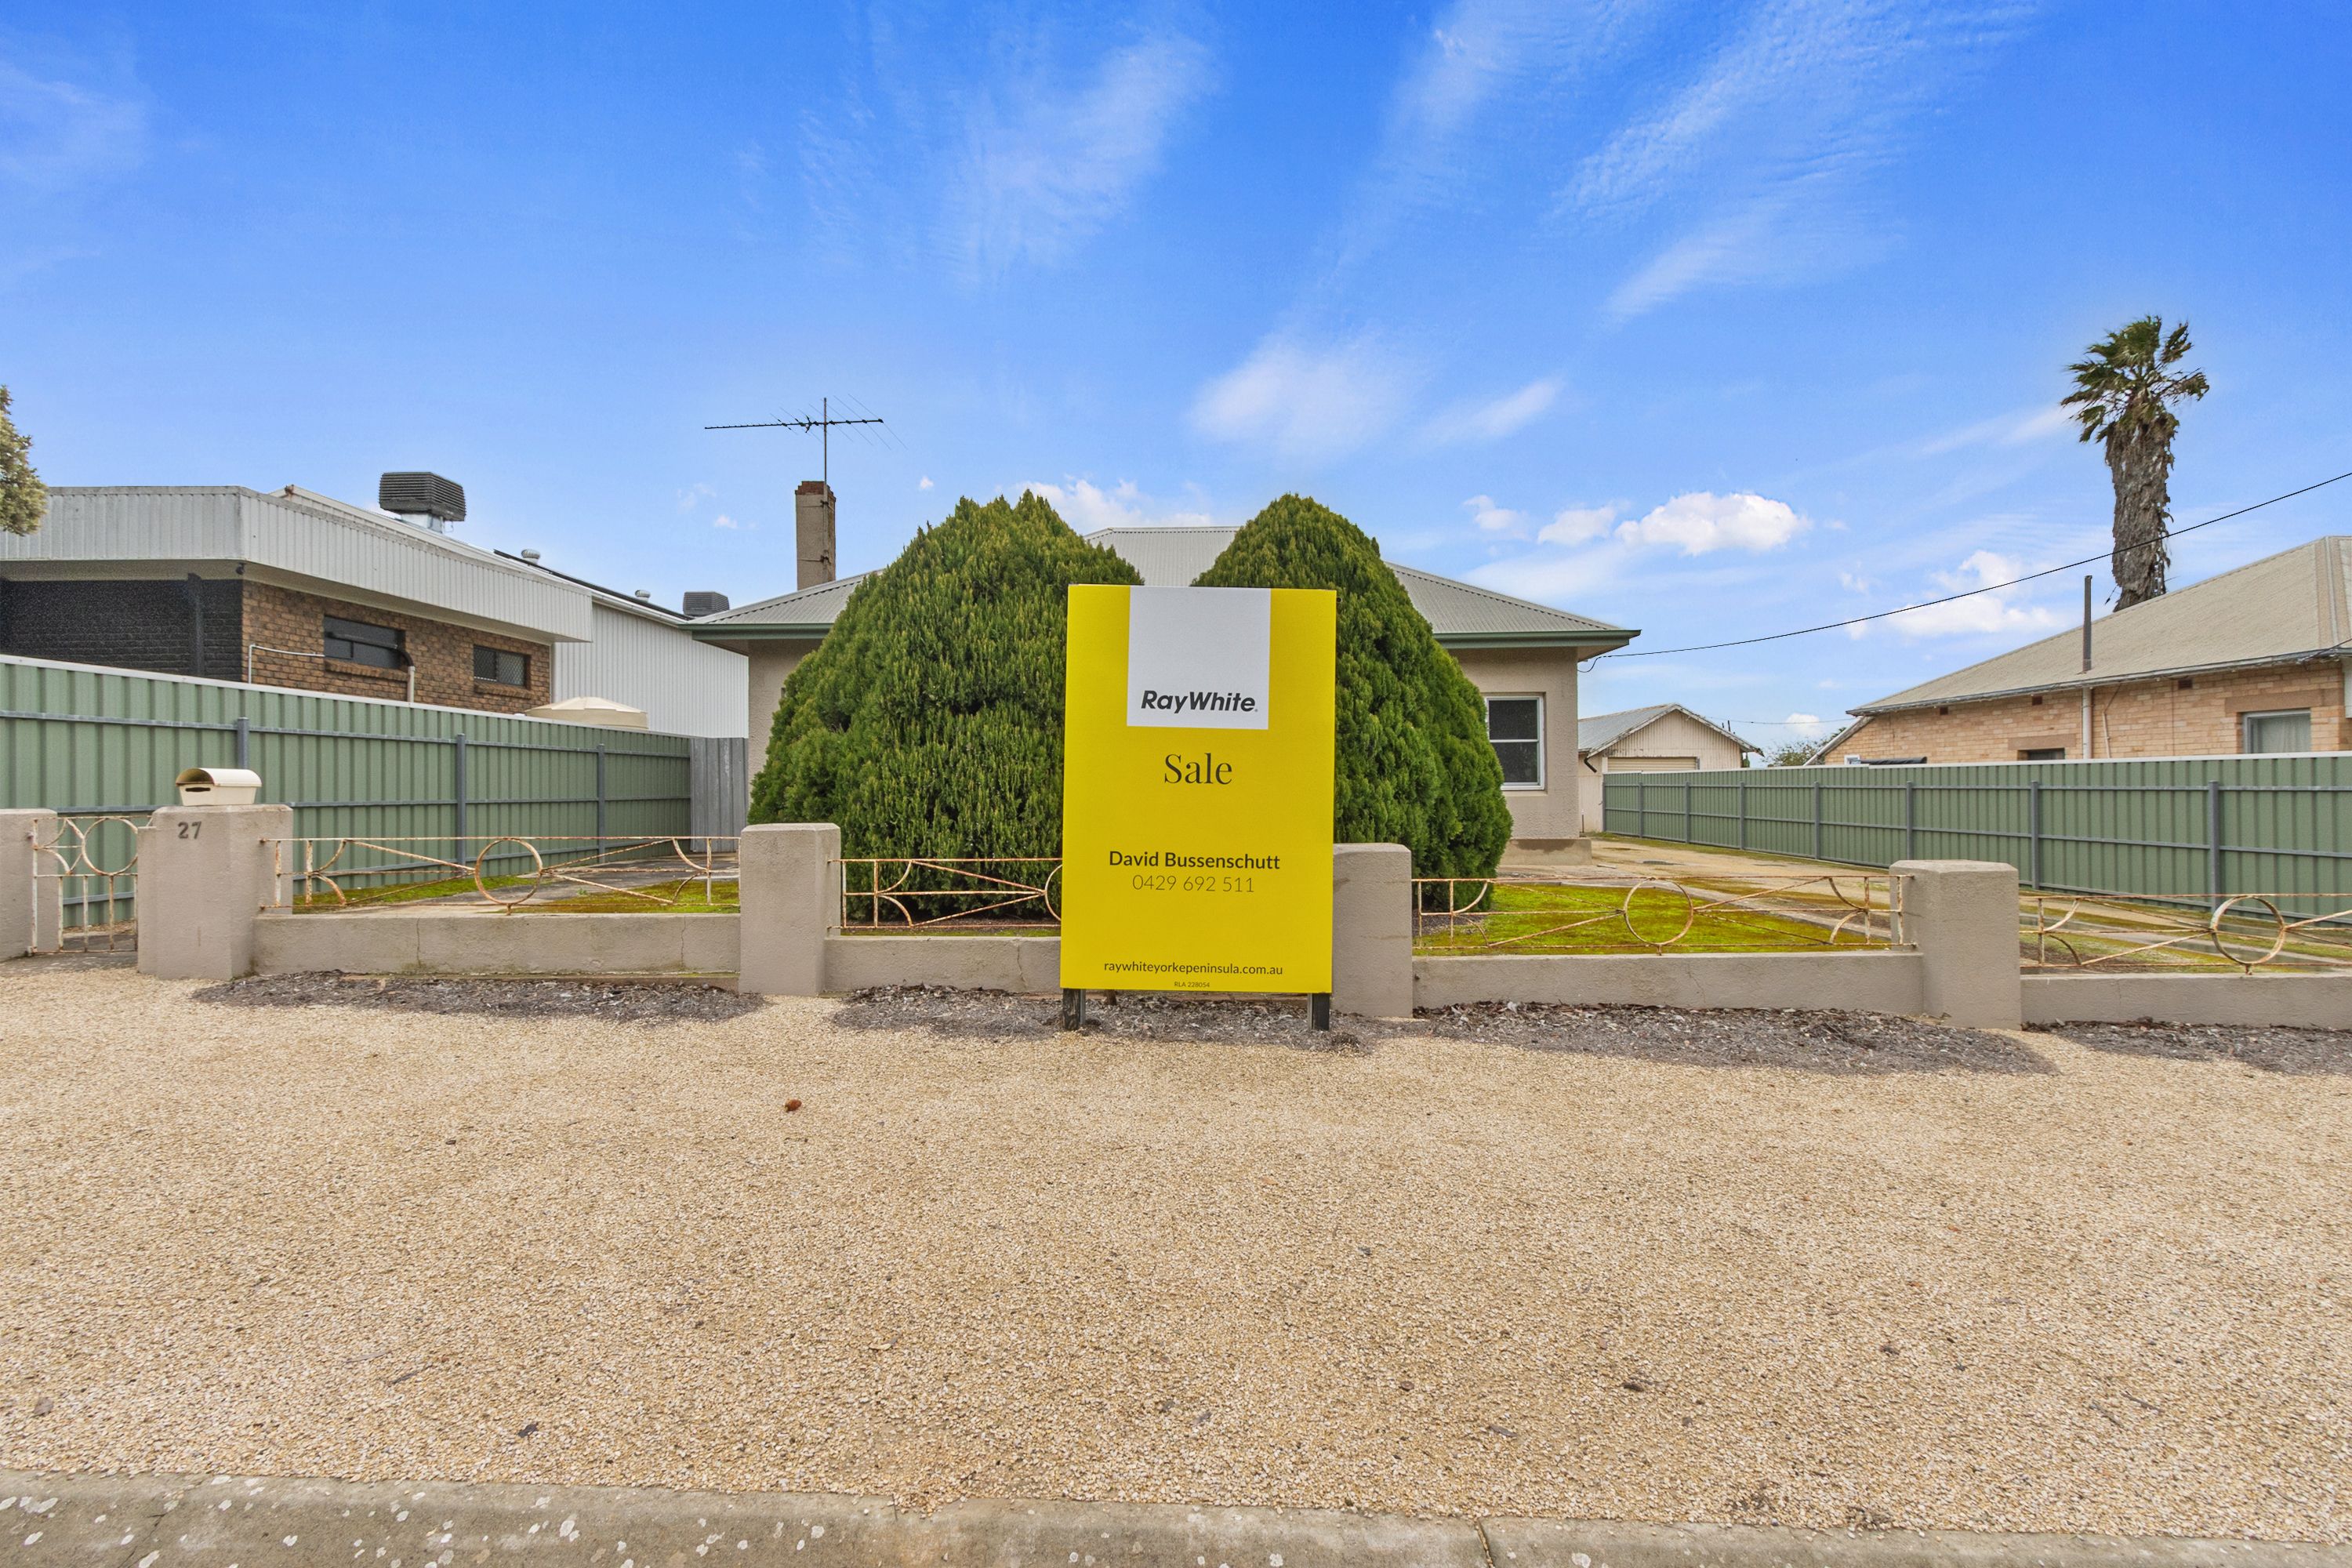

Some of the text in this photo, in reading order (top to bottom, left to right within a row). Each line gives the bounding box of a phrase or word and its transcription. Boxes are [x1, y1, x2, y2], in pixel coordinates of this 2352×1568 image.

[1164, 753, 1232, 785] Sale
[178, 821, 202, 840] 27
[1109, 851, 1280, 869] David Bussenschutt
[1132, 874, 1254, 893] 0429 692 511
[1104, 961, 1283, 975] raywhiteyorkepeninsula.com.au
